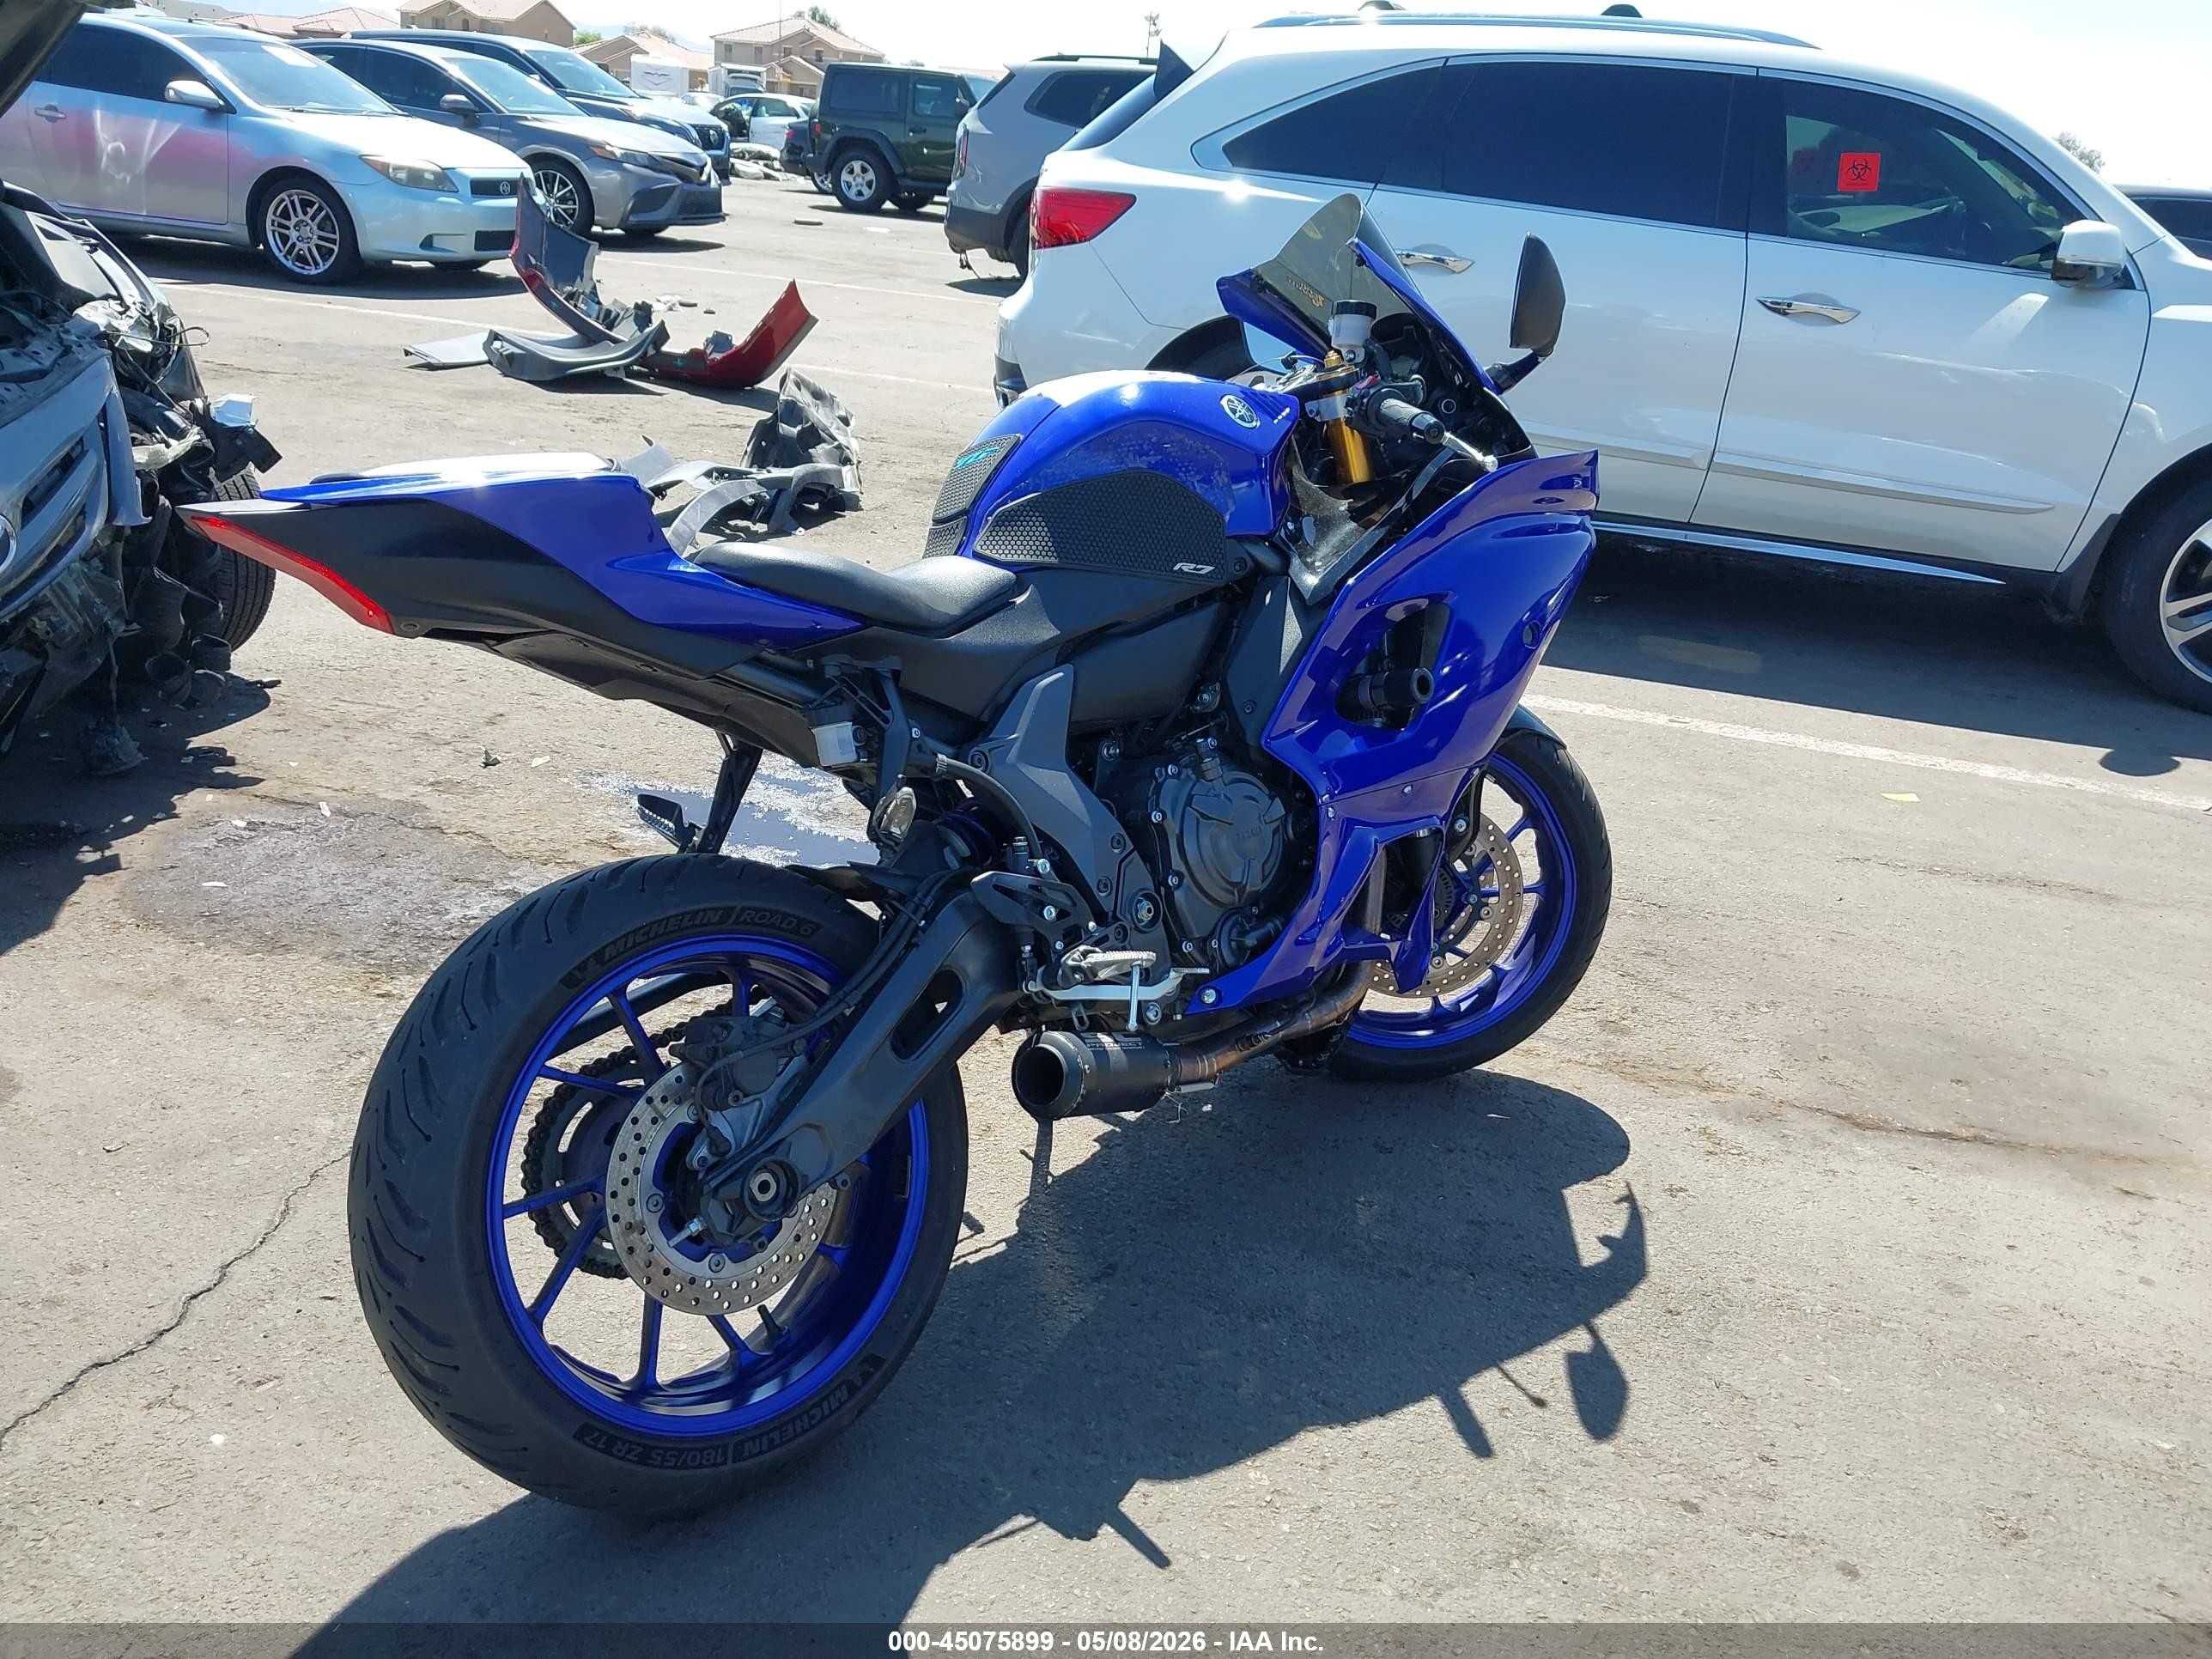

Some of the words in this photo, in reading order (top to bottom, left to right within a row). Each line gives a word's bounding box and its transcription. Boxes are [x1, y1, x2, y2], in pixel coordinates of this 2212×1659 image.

[1173, 562, 1215, 574] R7
[605, 910, 722, 960] MICHELIN
[741, 910, 798, 929] ROAD
[800, 921, 812, 935] 6
[743, 1387, 849, 1458] MICHELIN
[582, 1428, 606, 1447] 17
[611, 1440, 640, 1460] ZR
[651, 1446, 723, 1468] 180/55
